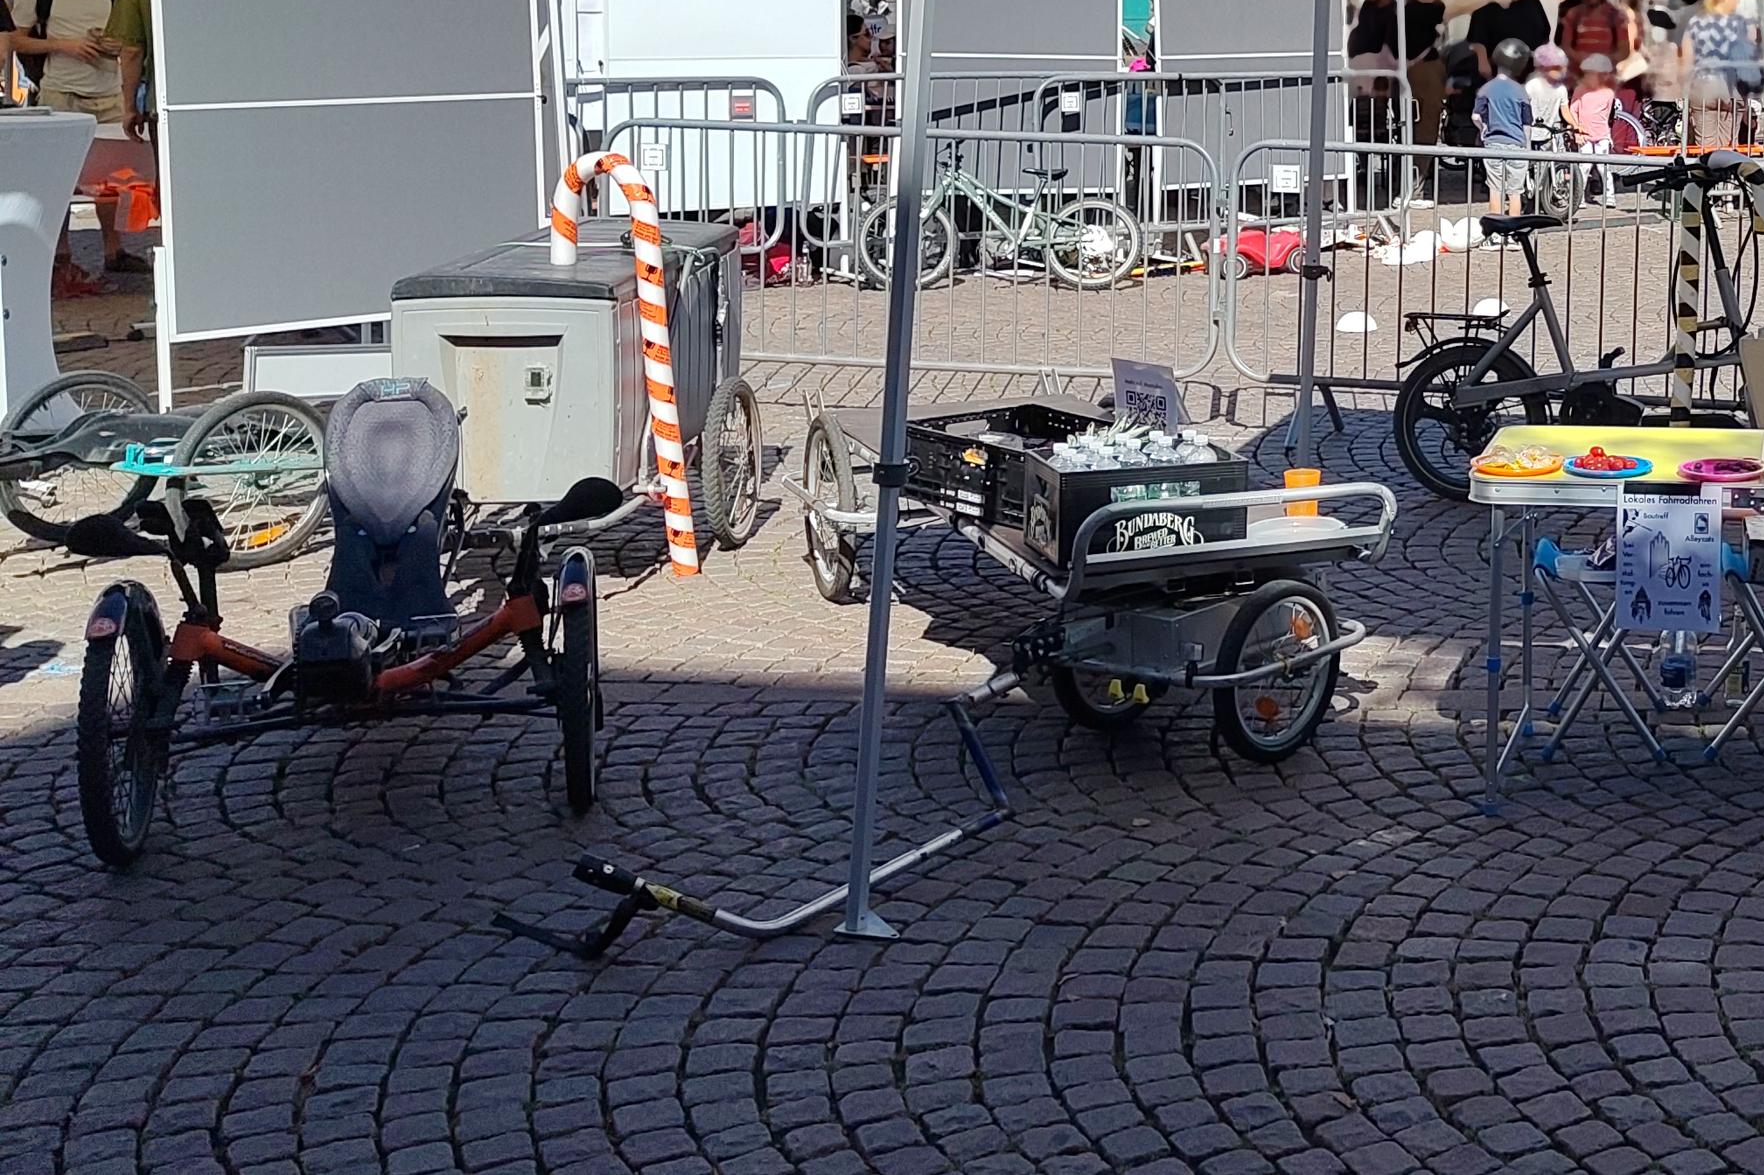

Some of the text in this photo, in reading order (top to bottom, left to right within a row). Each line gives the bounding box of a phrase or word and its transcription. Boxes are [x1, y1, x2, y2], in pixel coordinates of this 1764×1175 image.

[1623, 495, 1718, 505] Lokales Fahrradfahren
[1115, 512, 1196, 552] BUNDABERG
